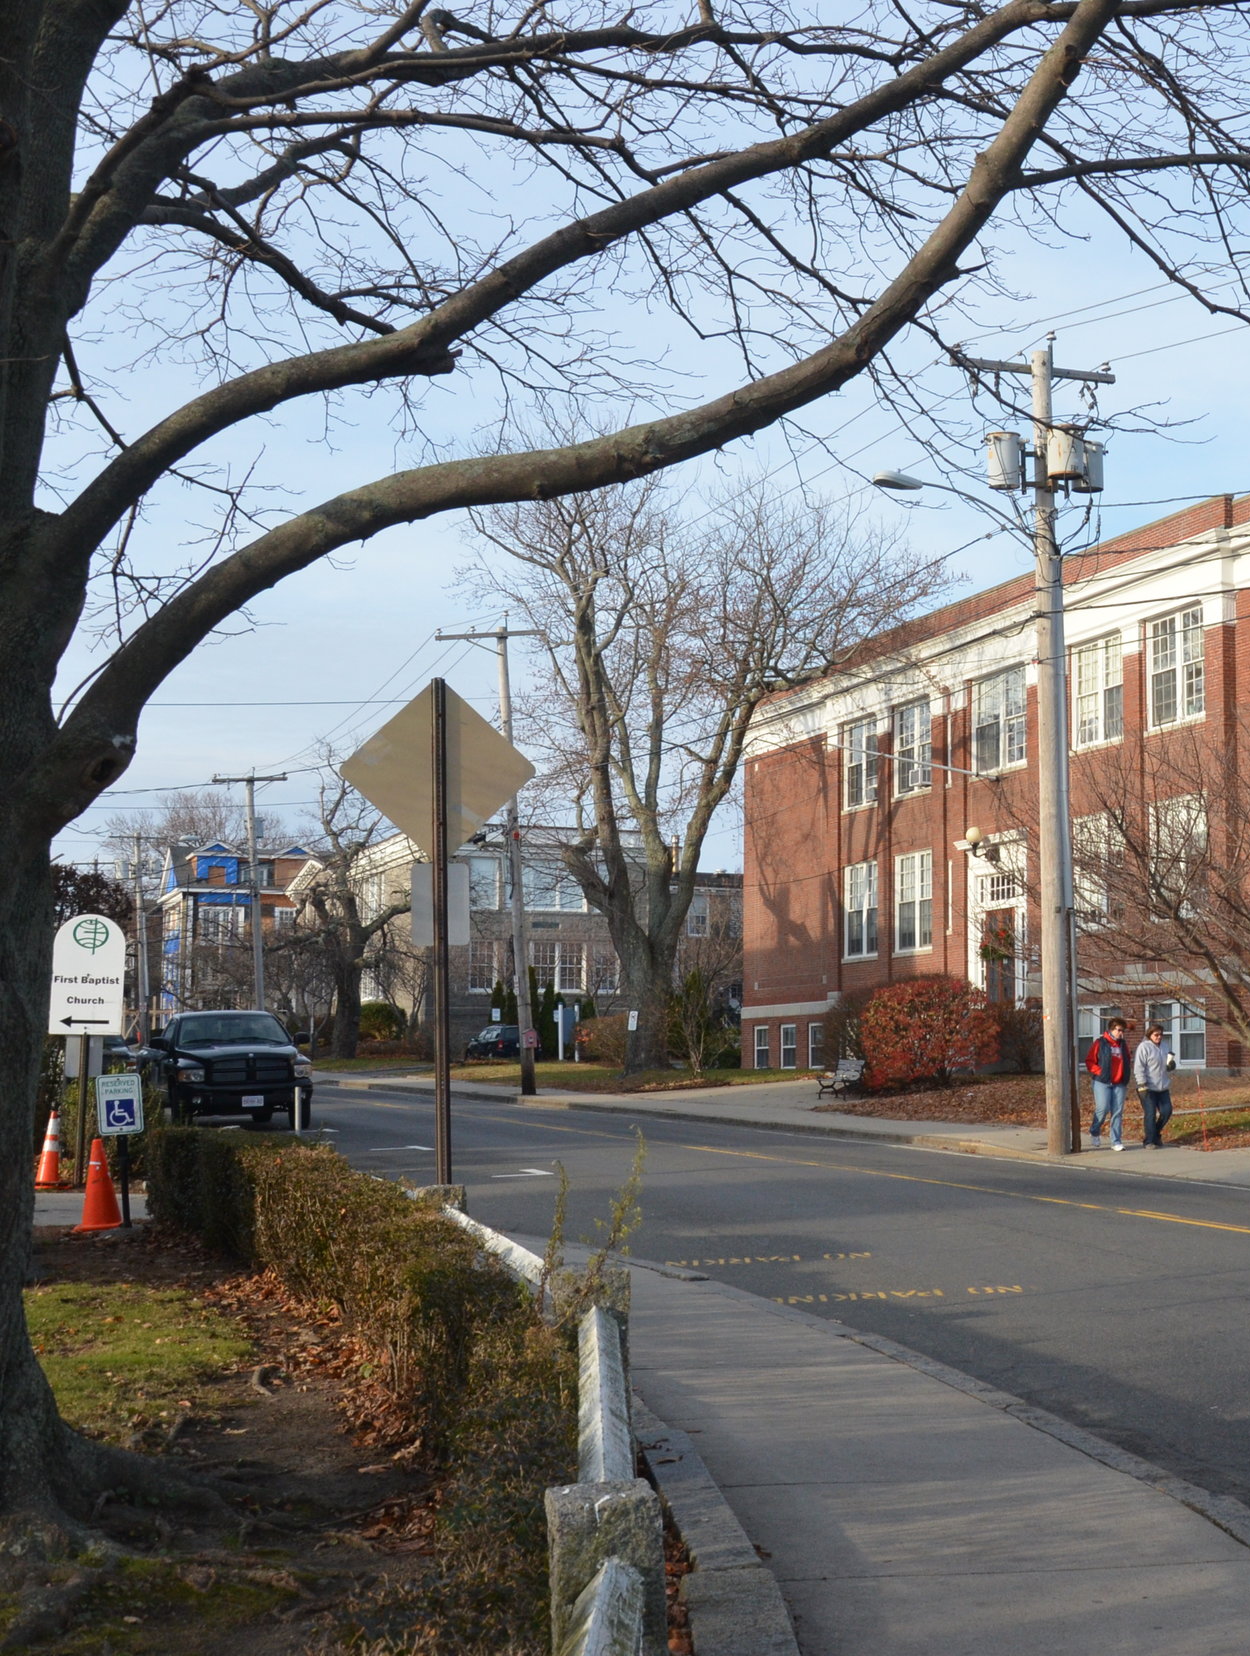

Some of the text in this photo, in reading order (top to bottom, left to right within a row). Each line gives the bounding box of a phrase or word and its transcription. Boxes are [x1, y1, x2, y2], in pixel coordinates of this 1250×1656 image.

[54, 975, 120, 986] First Baptist
[66, 996, 105, 1005] Church
[101, 1080, 135, 1088] RESERVED
